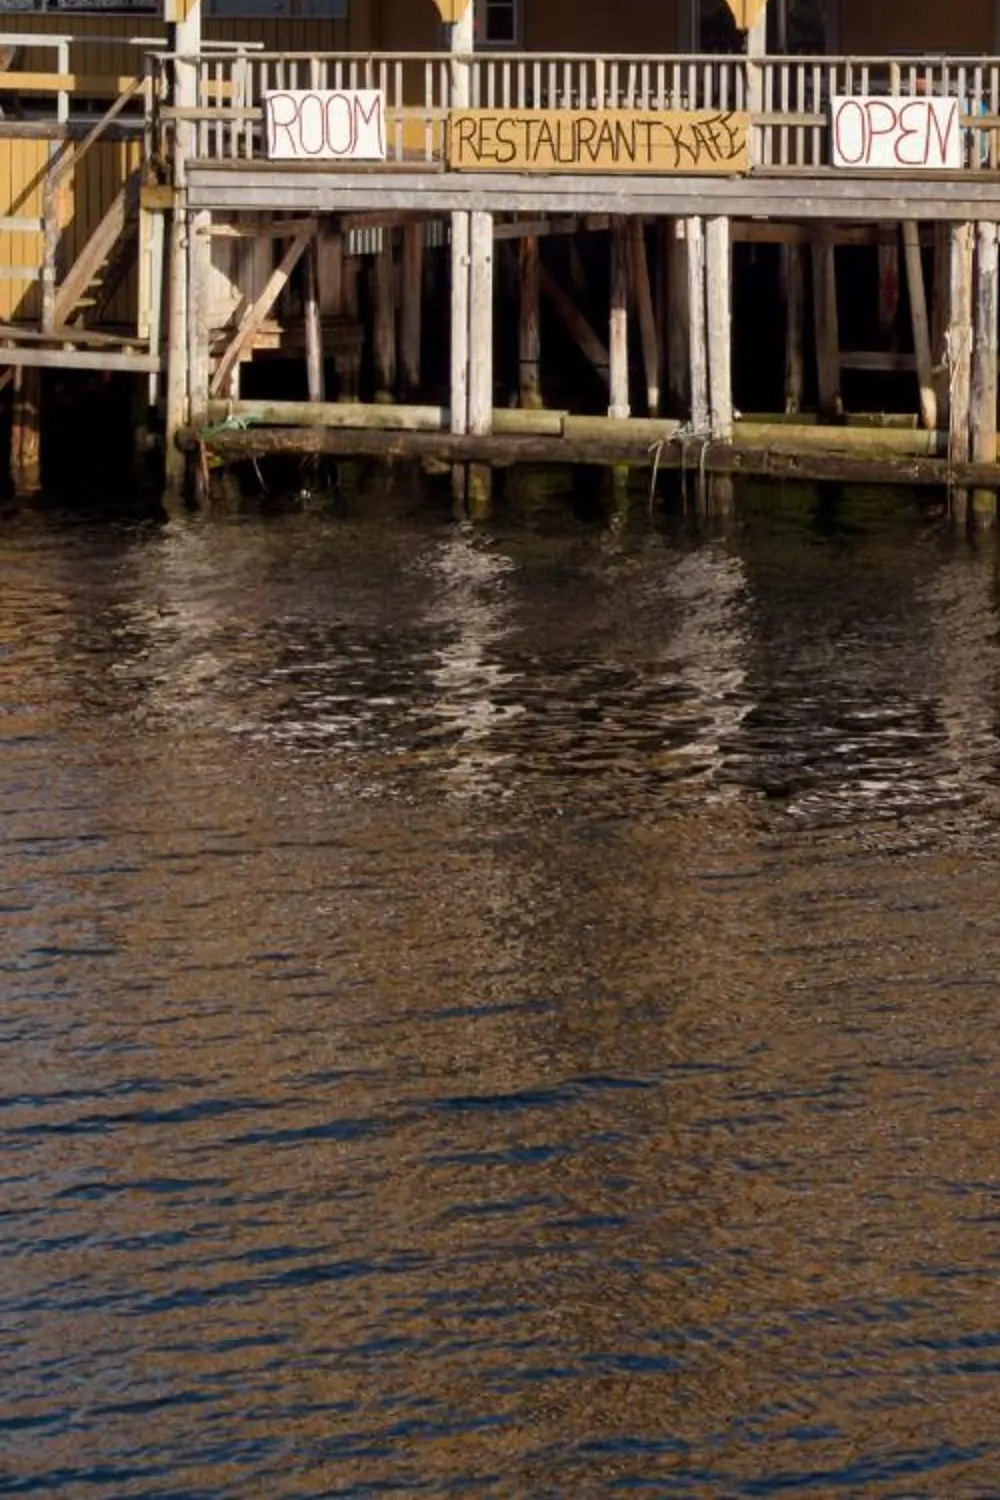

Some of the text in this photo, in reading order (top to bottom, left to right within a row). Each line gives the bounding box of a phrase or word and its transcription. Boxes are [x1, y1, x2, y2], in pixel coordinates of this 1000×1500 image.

[267, 93, 385, 155] ROOM
[454, 110, 747, 169] RESTAURANT KAFE
[834, 99, 957, 165] OPEN
